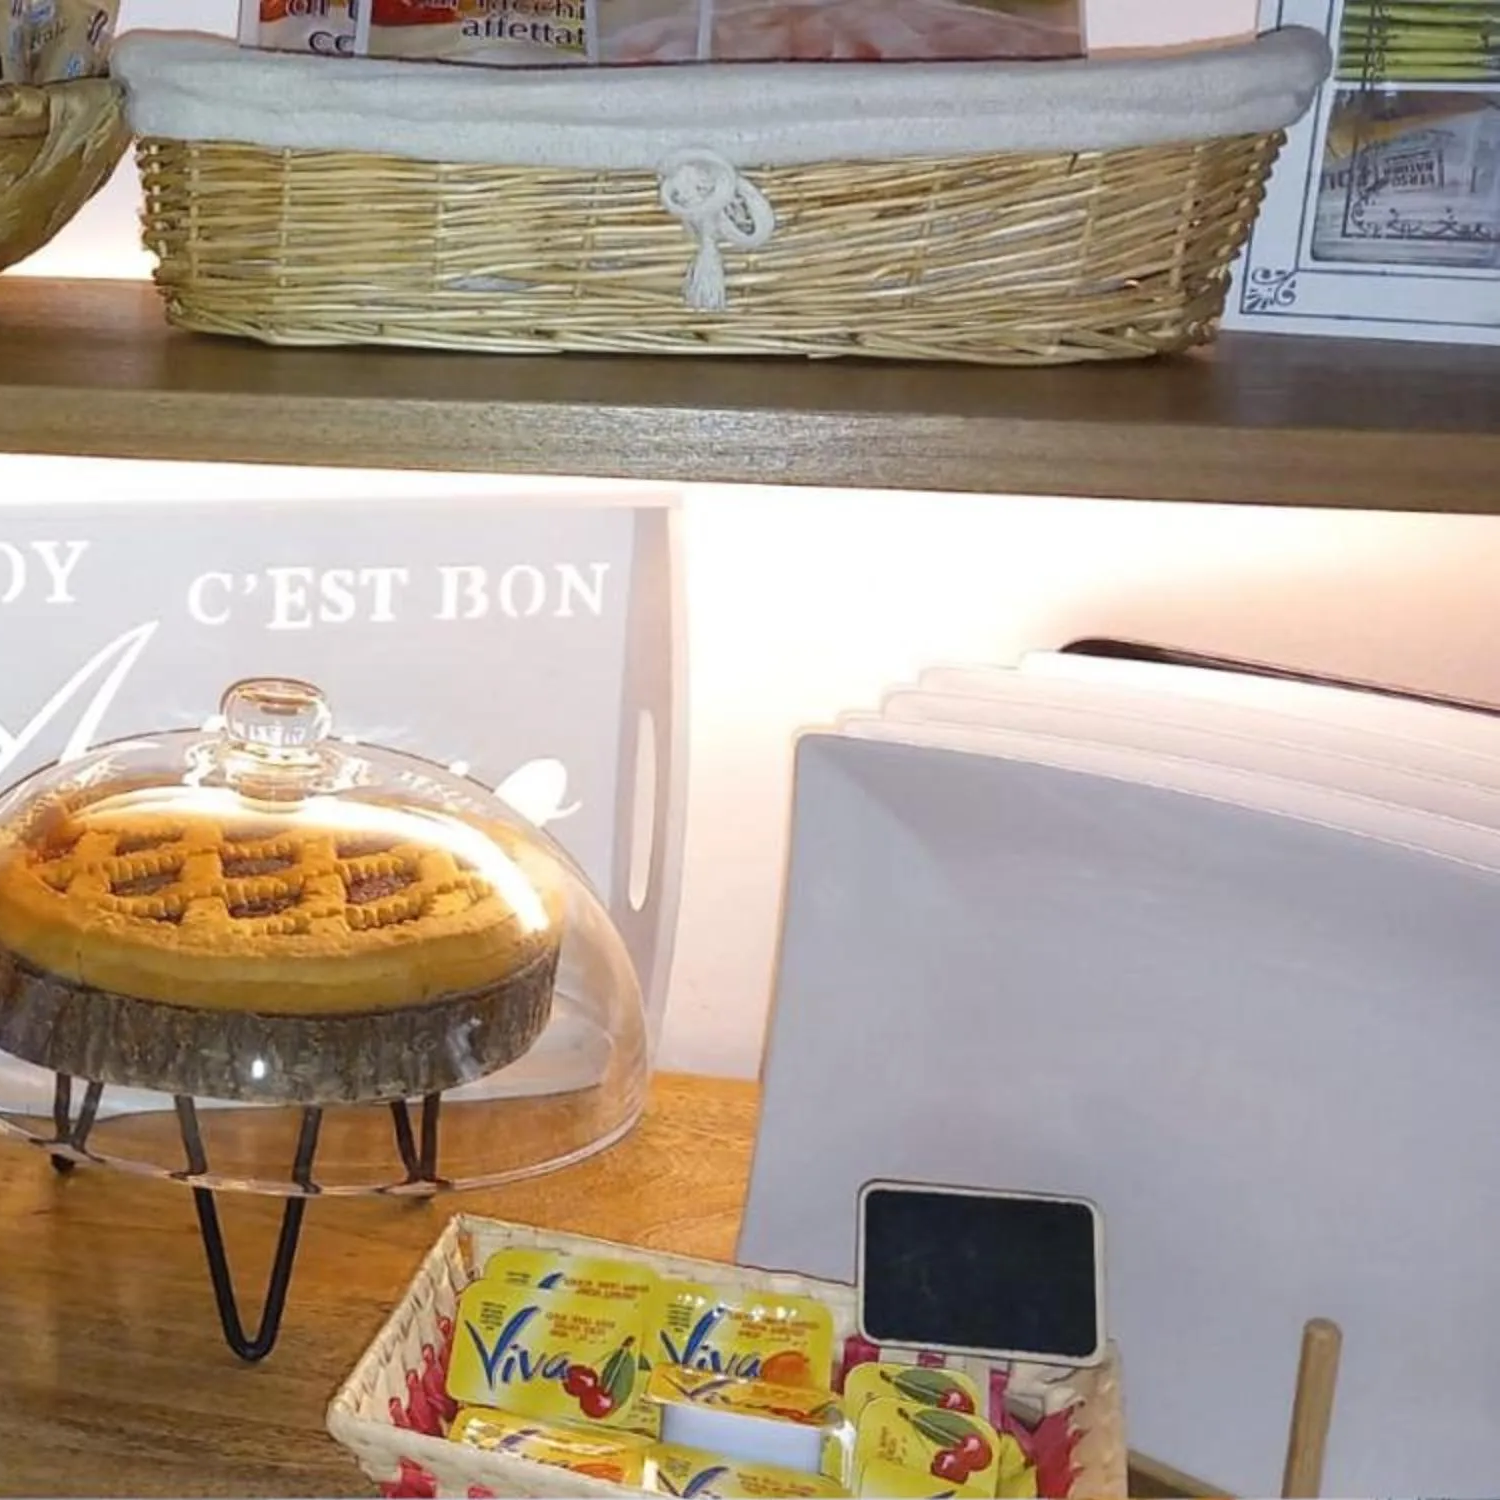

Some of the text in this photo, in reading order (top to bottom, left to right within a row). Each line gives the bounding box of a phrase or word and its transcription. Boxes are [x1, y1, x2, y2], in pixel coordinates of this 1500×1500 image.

[462, 17, 586, 45] affettat
[432, 560, 612, 620] BON
[464, 1305, 570, 1390] Viva
